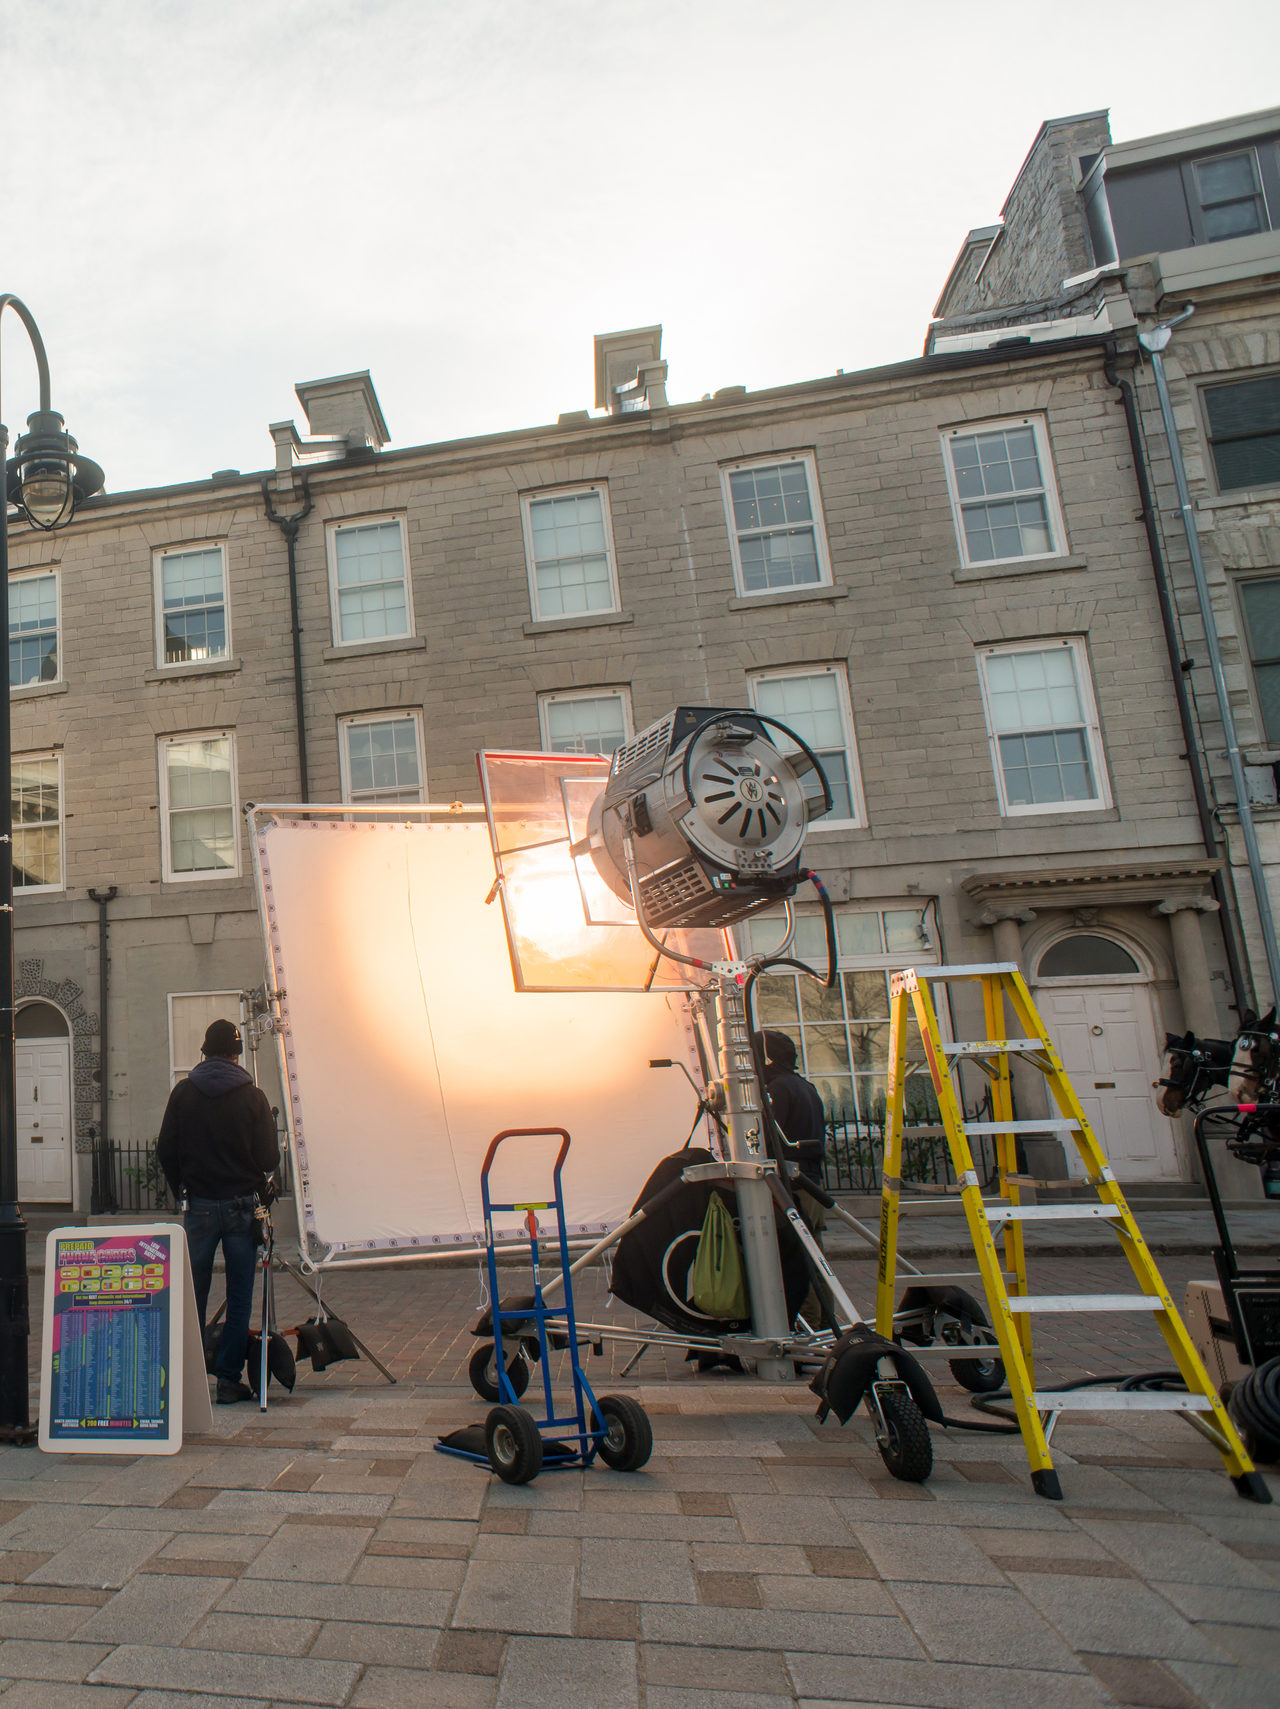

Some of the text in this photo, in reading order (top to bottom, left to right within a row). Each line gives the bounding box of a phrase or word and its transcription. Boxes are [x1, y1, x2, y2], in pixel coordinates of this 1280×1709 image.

[59, 1241, 94, 1252] PREPAID
[58, 1248, 136, 1266] PHONE CARDS
